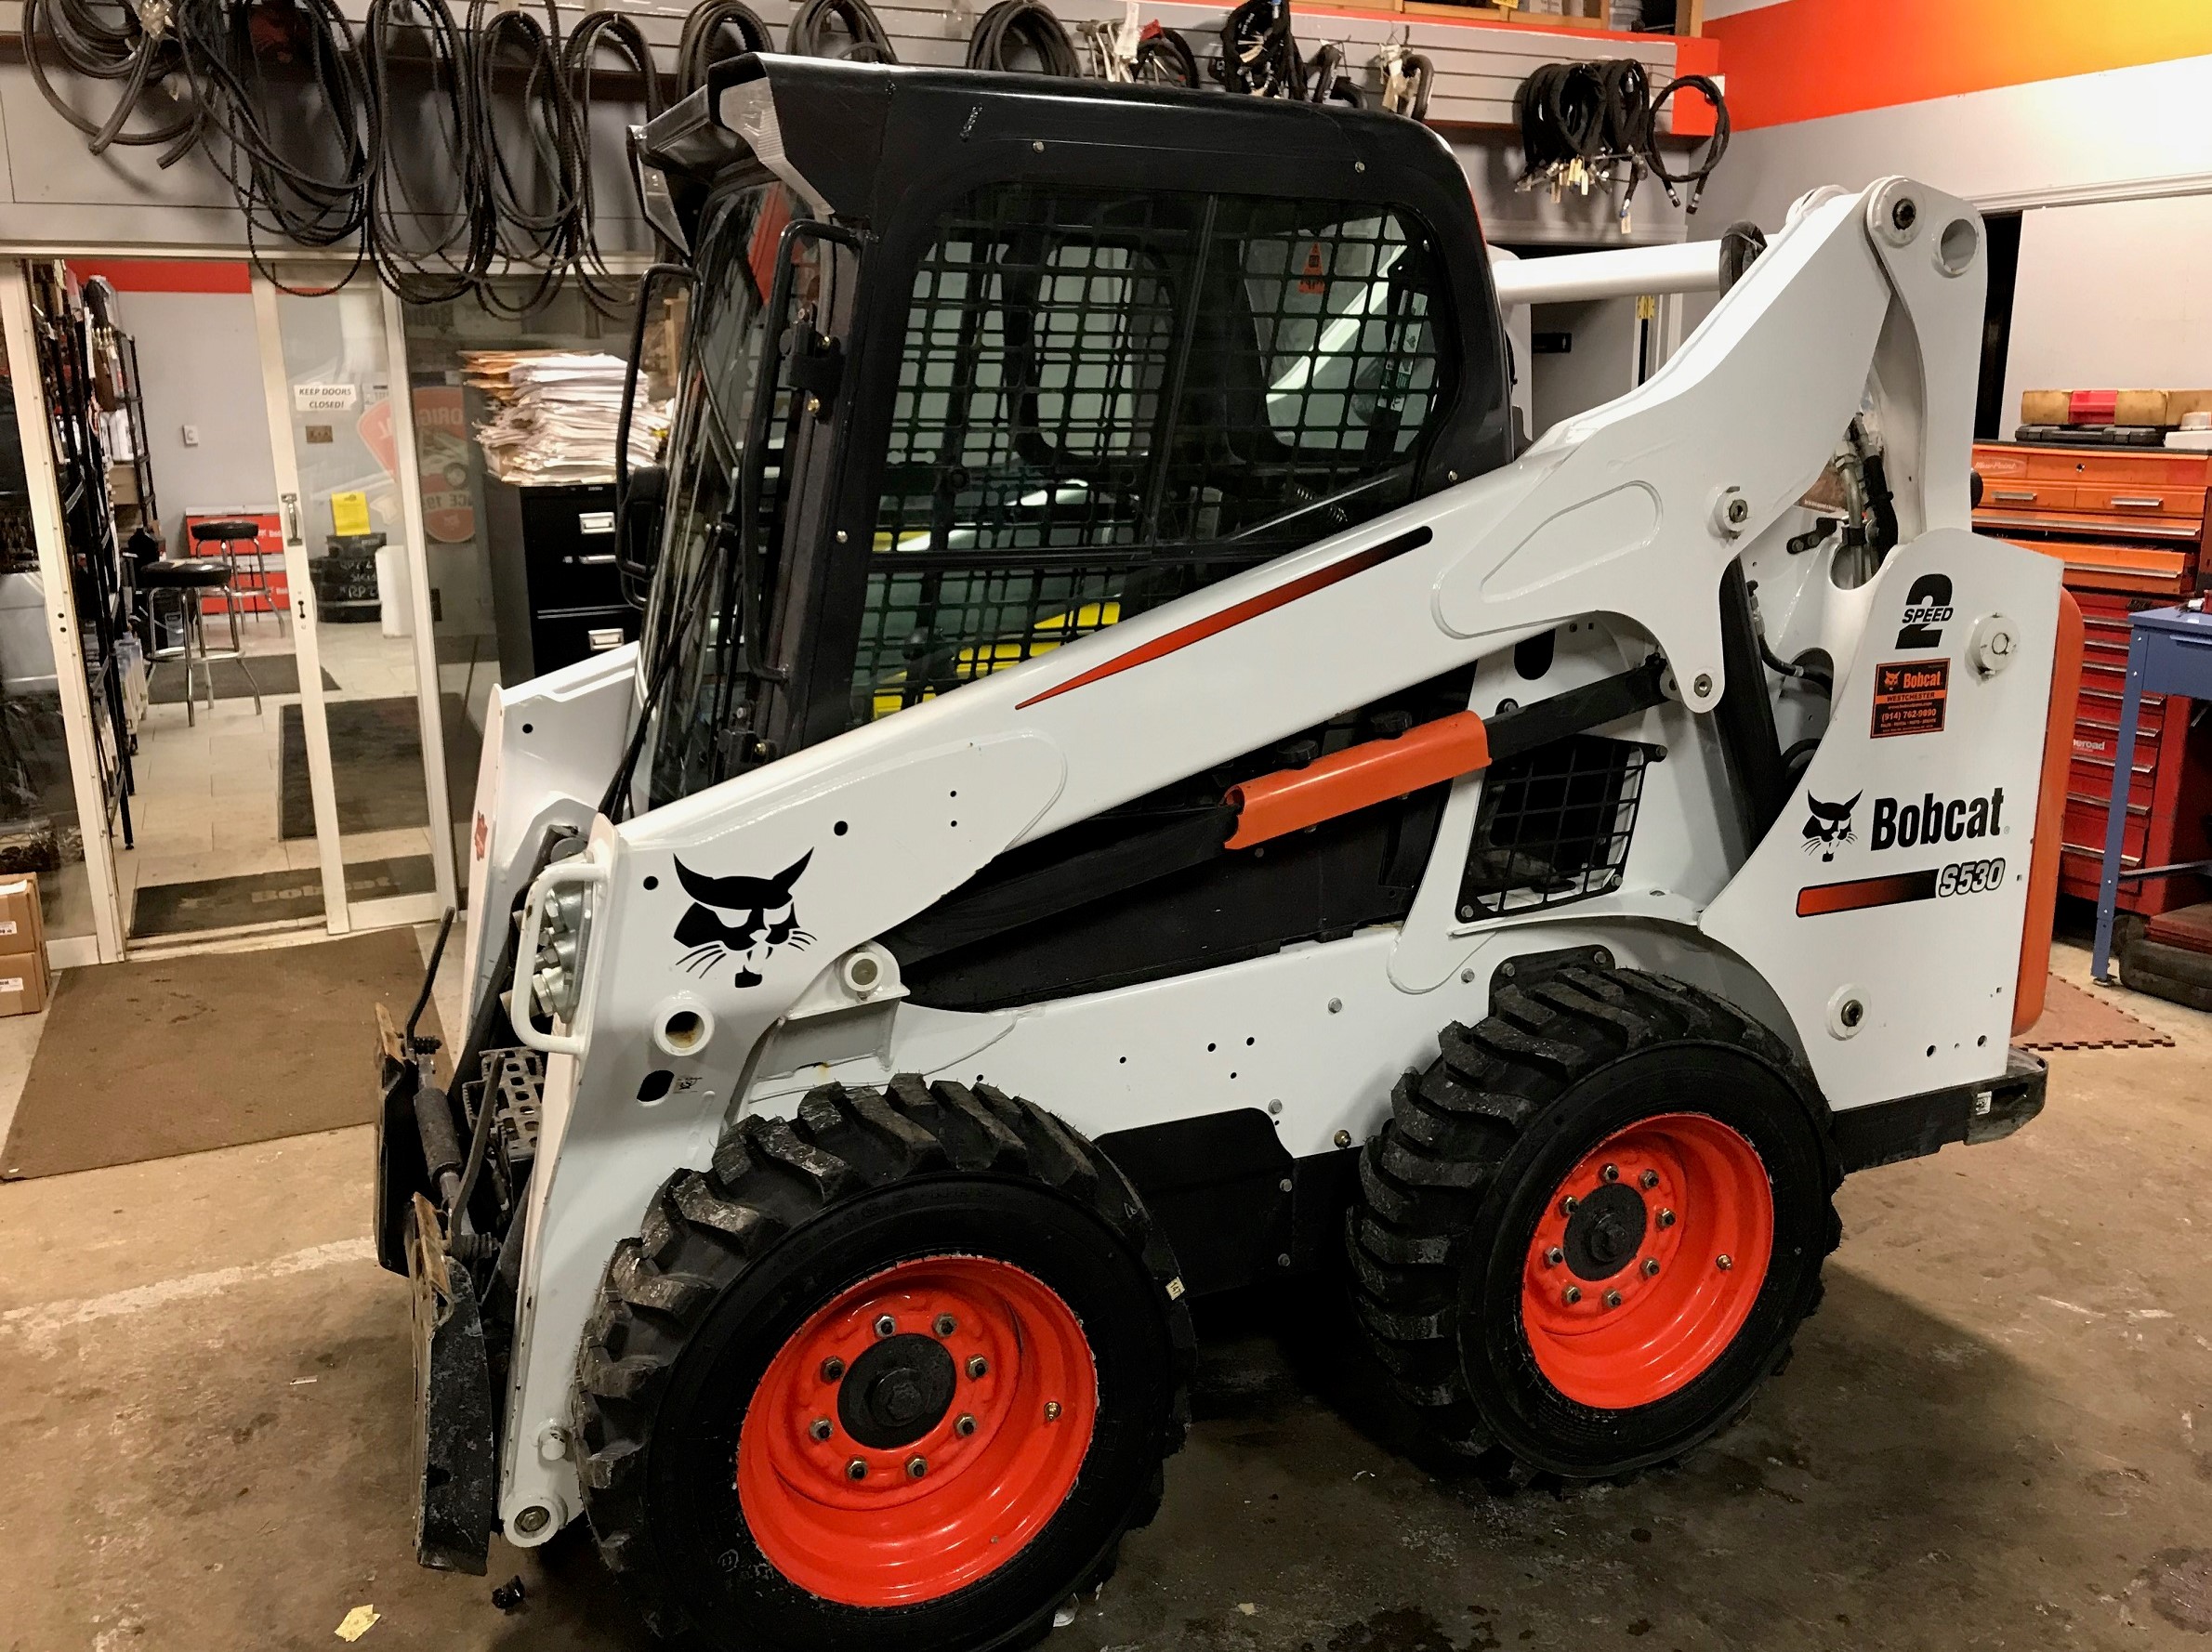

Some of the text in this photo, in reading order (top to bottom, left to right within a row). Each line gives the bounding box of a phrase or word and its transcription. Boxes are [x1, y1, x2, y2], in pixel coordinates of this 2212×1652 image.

[299, 387, 351, 396] KEEP DOORS
[309, 400, 344, 409] CLOSED!
[1902, 607, 1954, 623] SPEED
[1903, 670, 1942, 688] Bobcat
[1887, 692, 1935, 702] WESTCHESTER
[1881, 712, 1902, 723] (914)
[1870, 787, 2004, 851] Bobcat
[1938, 858, 2007, 898] S530
